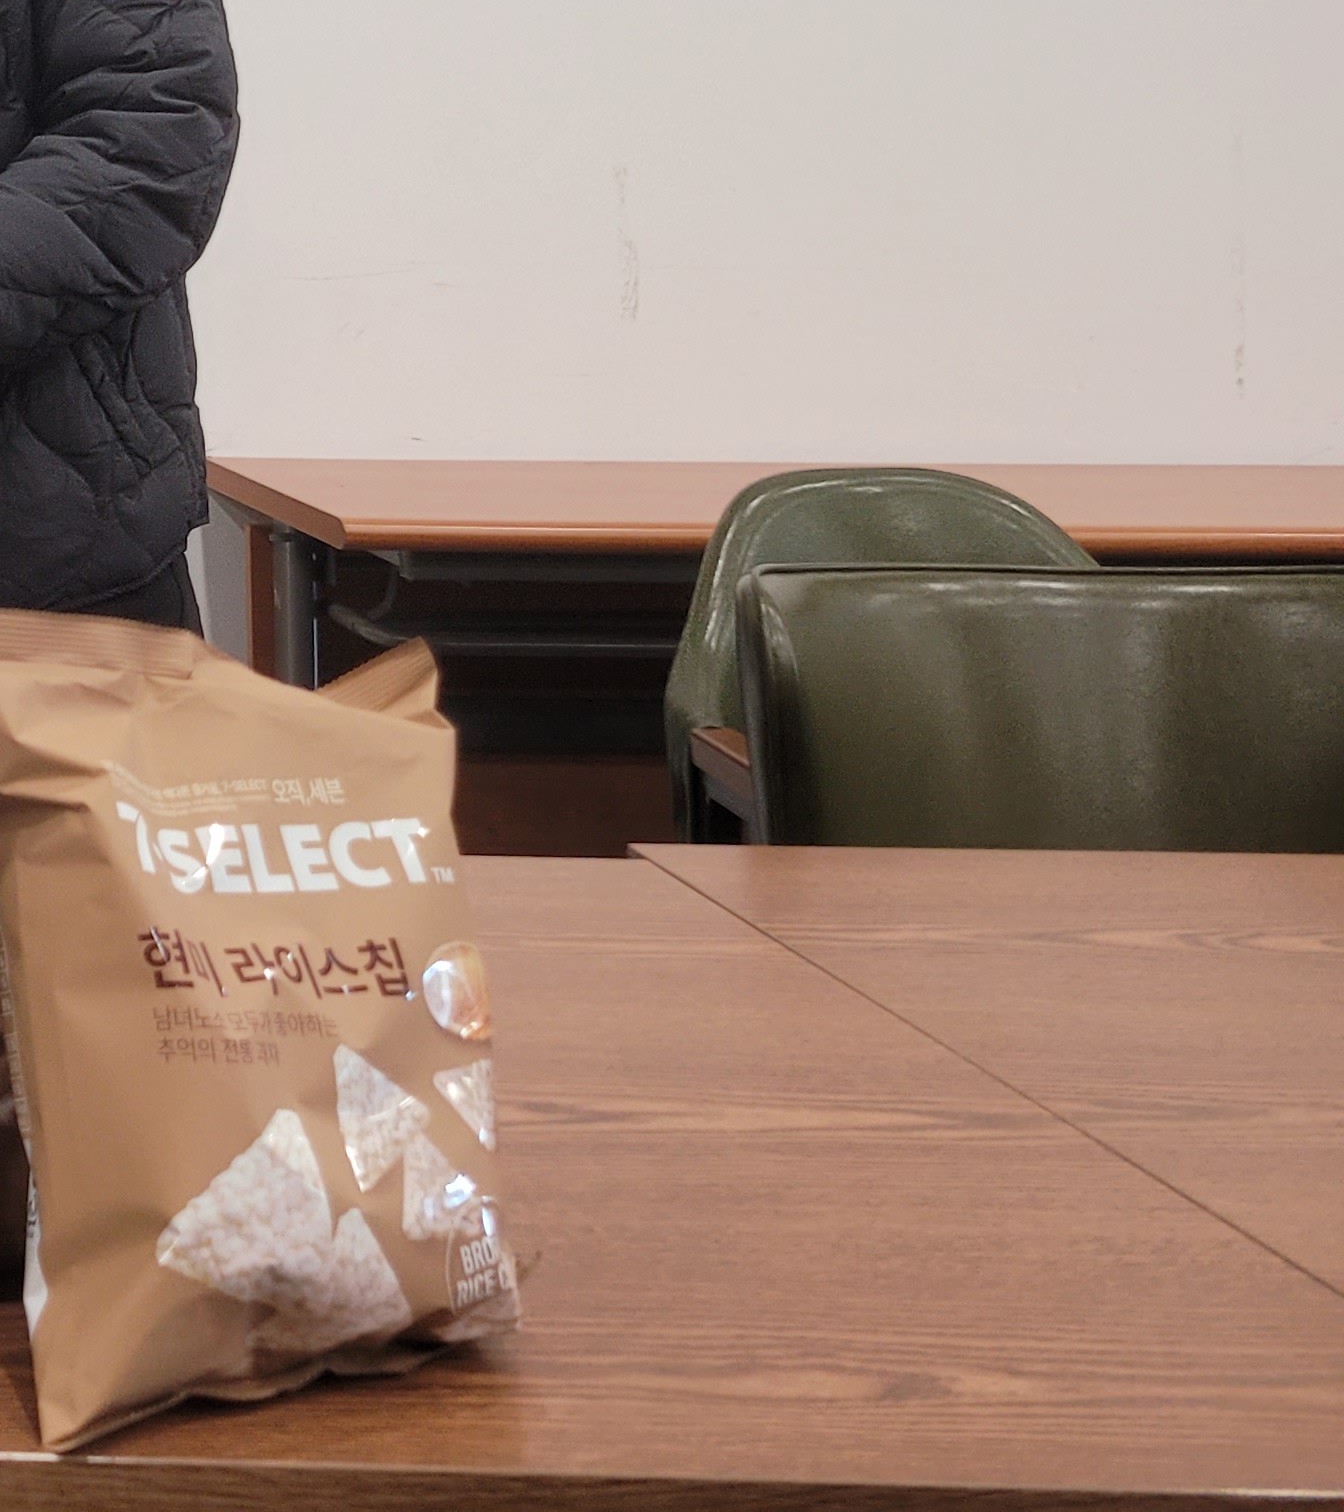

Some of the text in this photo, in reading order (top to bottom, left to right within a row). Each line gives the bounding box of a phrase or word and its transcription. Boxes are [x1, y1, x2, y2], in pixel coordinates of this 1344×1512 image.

[224, 937, 411, 999] 라이스칩
[158, 1038, 216, 1064] 추억의
[223, 1038, 255, 1064] 전통
[457, 1267, 498, 1308] RICE
